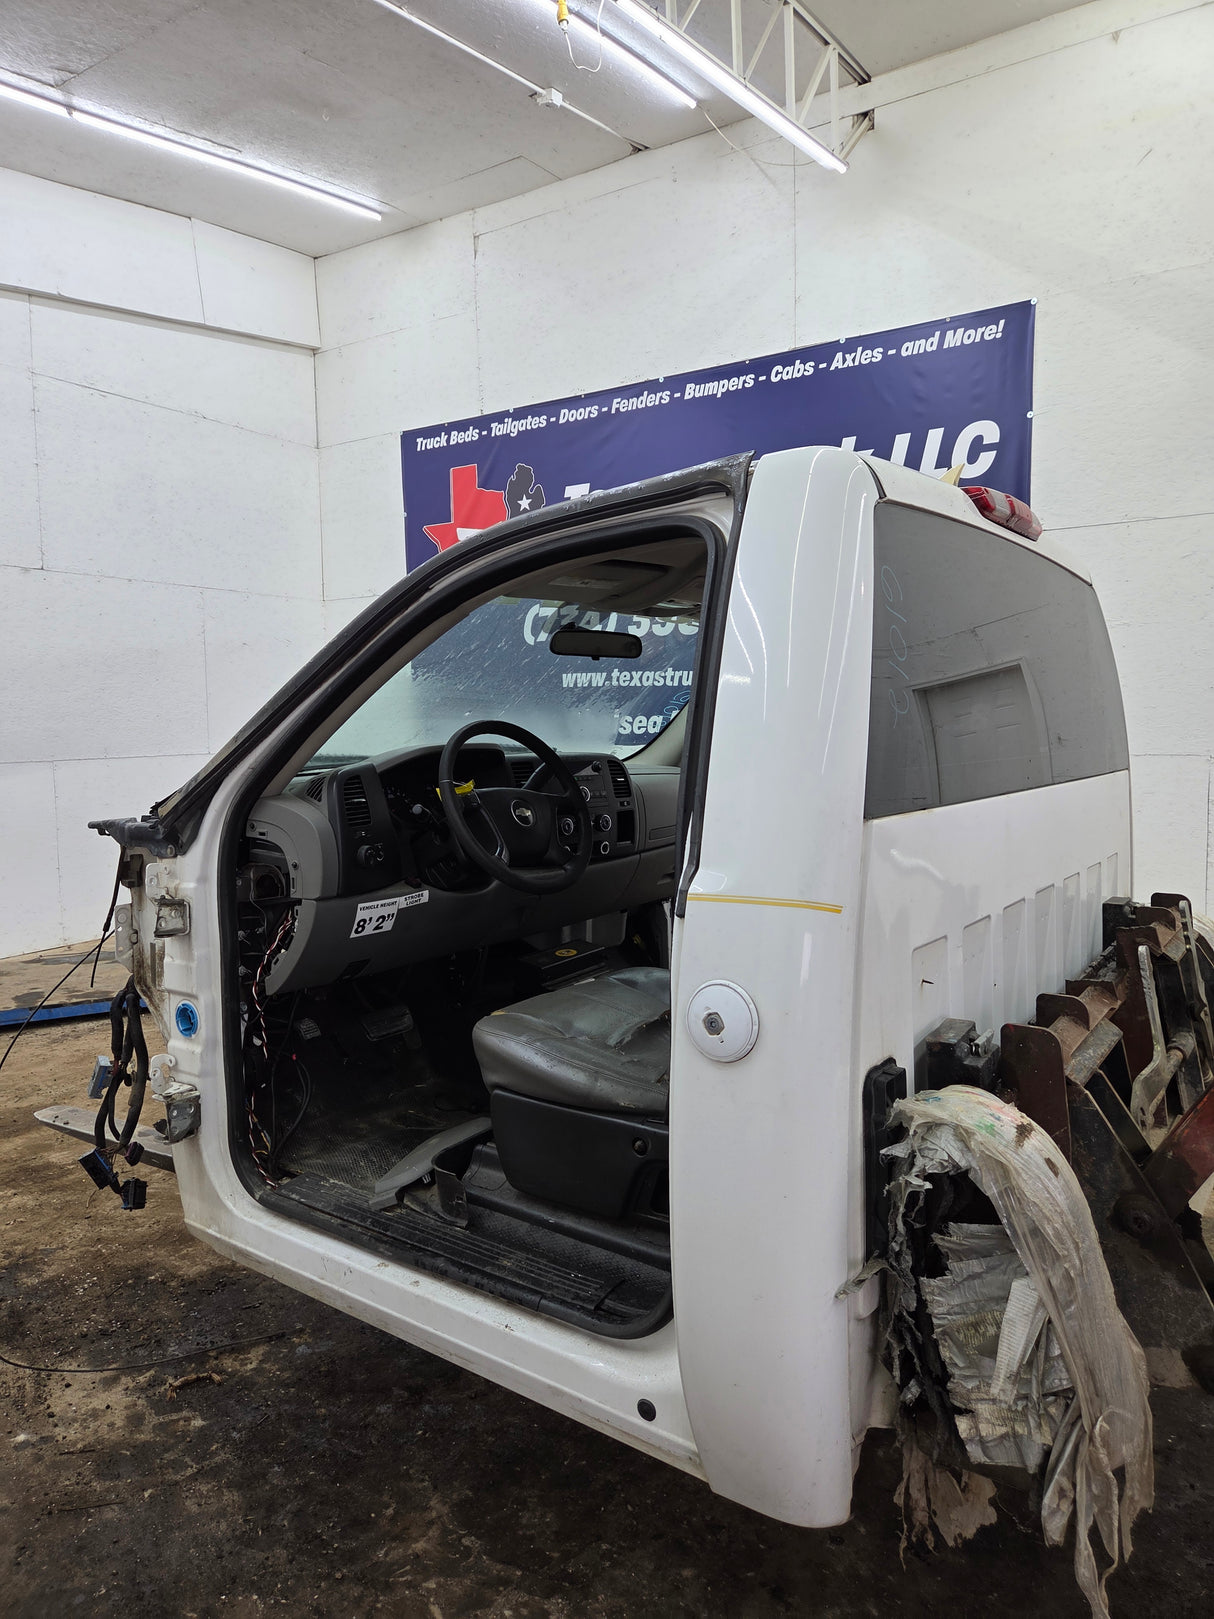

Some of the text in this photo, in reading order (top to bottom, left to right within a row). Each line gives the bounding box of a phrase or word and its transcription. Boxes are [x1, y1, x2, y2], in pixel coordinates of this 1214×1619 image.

[416, 432, 448, 452] Truck
[450, 426, 479, 446] Beds
[491, 414, 547, 437] Tailgates
[559, 404, 598, 424] Doors
[611, 390, 671, 414] Fenders
[684, 372, 755, 400] Bumpers
[770, 360, 814, 383] Cabs
[830, 346, 883, 371] Axles
[901, 331, 940, 357] and
[943, 319, 1006, 349] More!
[404, 892, 424, 902] STROBE
[406, 898, 422, 906] LIGHT
[360, 901, 398, 912] VEHICLE HEIGHT
